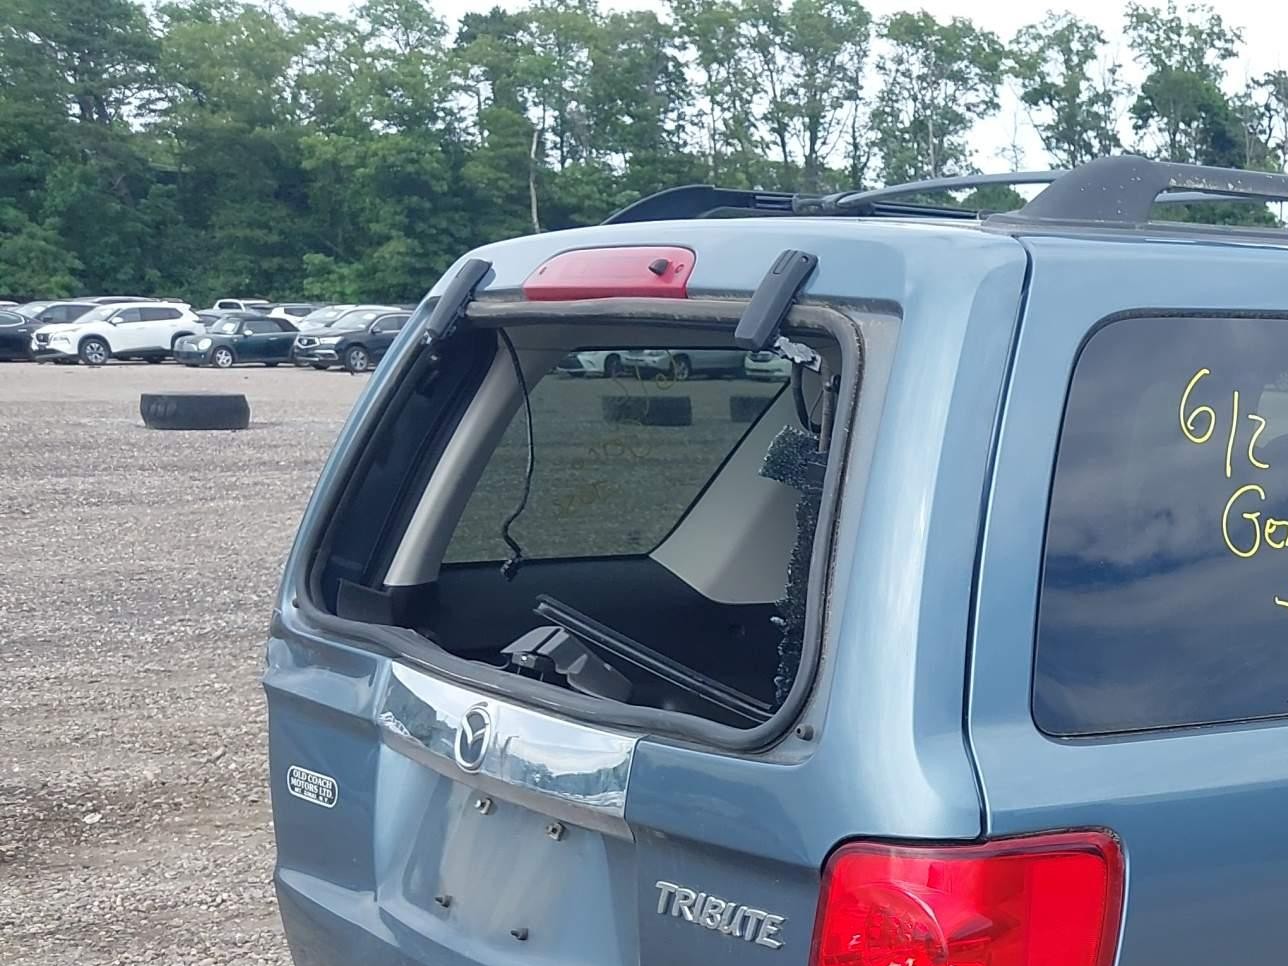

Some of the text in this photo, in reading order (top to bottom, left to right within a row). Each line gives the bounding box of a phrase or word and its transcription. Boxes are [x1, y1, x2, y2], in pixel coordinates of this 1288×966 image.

[290, 776, 318, 794] MOTORS
[292, 769, 332, 789] OLD COACH
[655, 880, 788, 950] TRIBUTE
